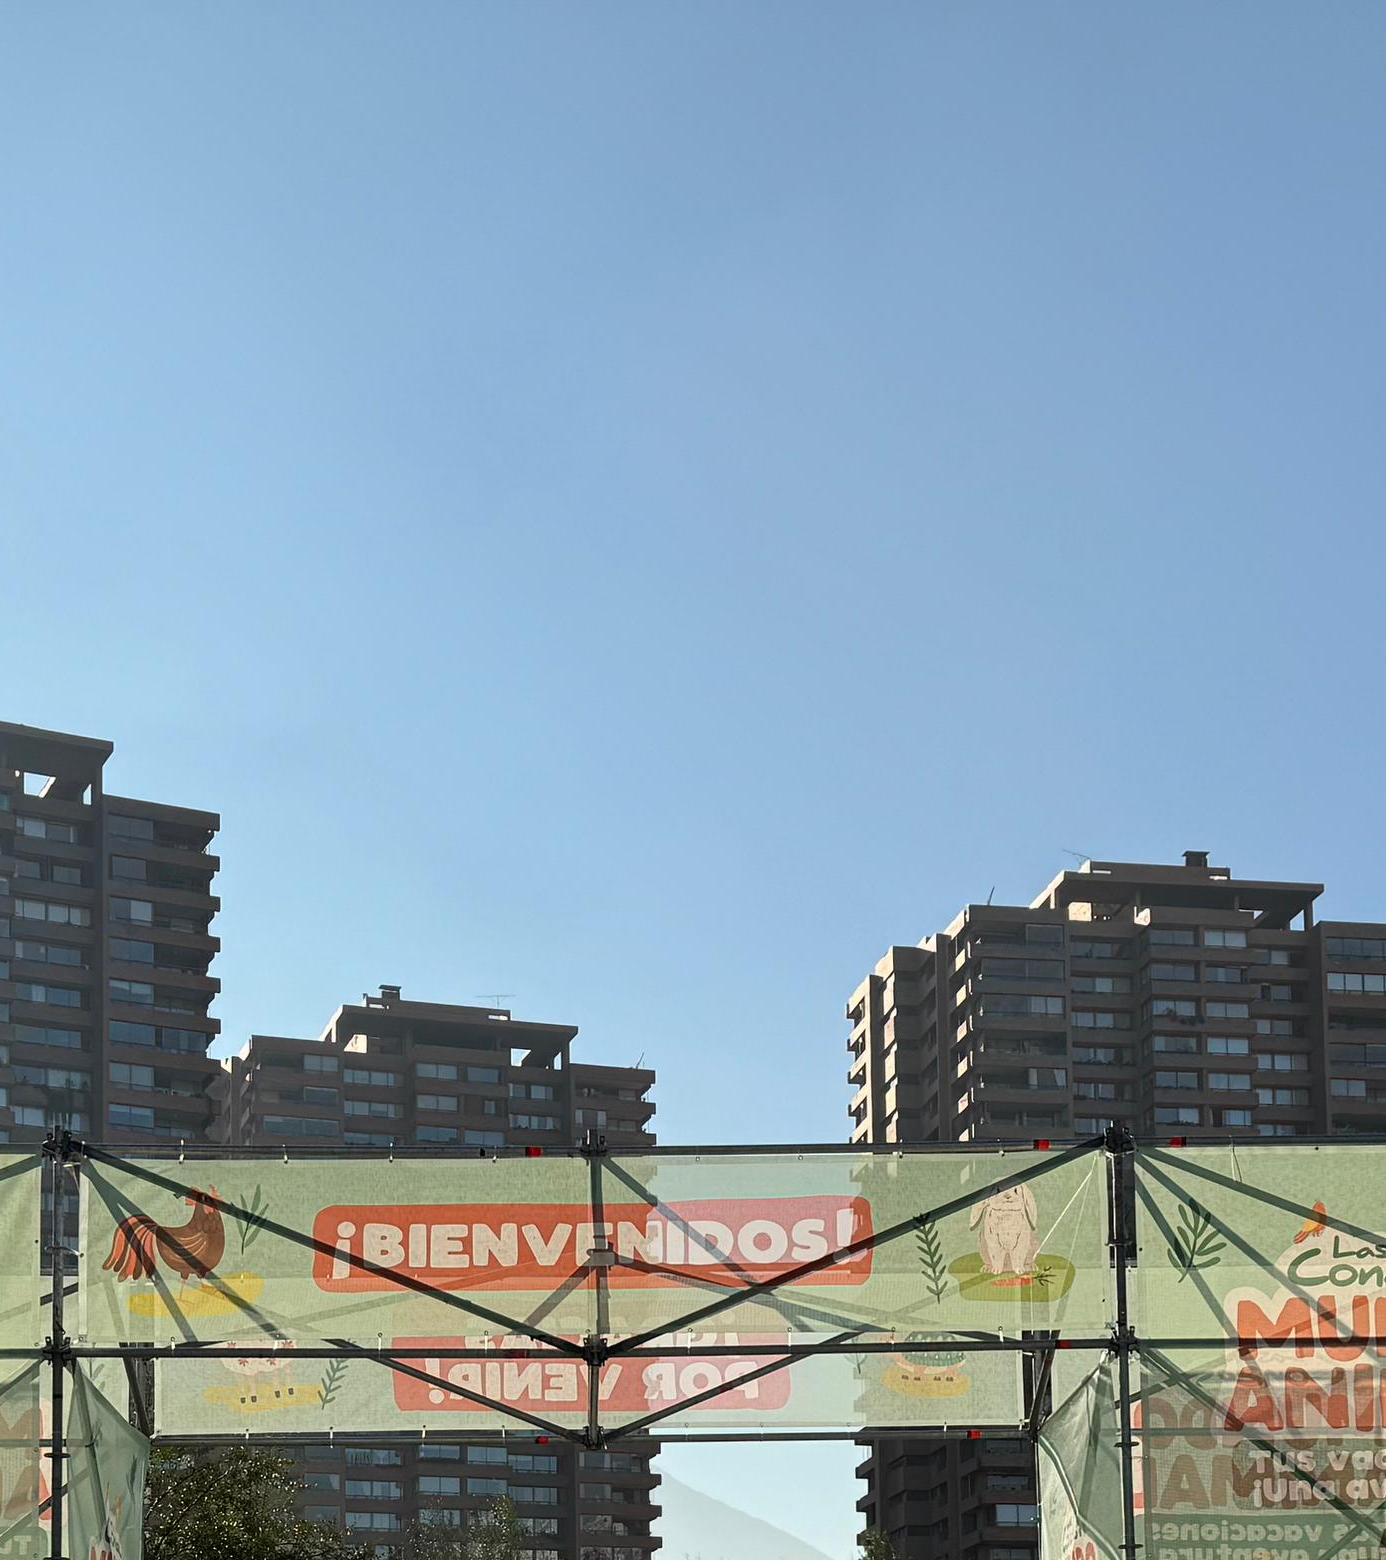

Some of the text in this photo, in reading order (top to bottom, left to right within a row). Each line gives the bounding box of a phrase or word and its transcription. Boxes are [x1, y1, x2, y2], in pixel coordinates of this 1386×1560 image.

[330, 1208, 868, 1279] ¡BIENVENIDOS!
[1249, 1450, 1316, 1474] Tus
[1253, 1478, 1331, 1508] ¡Una
